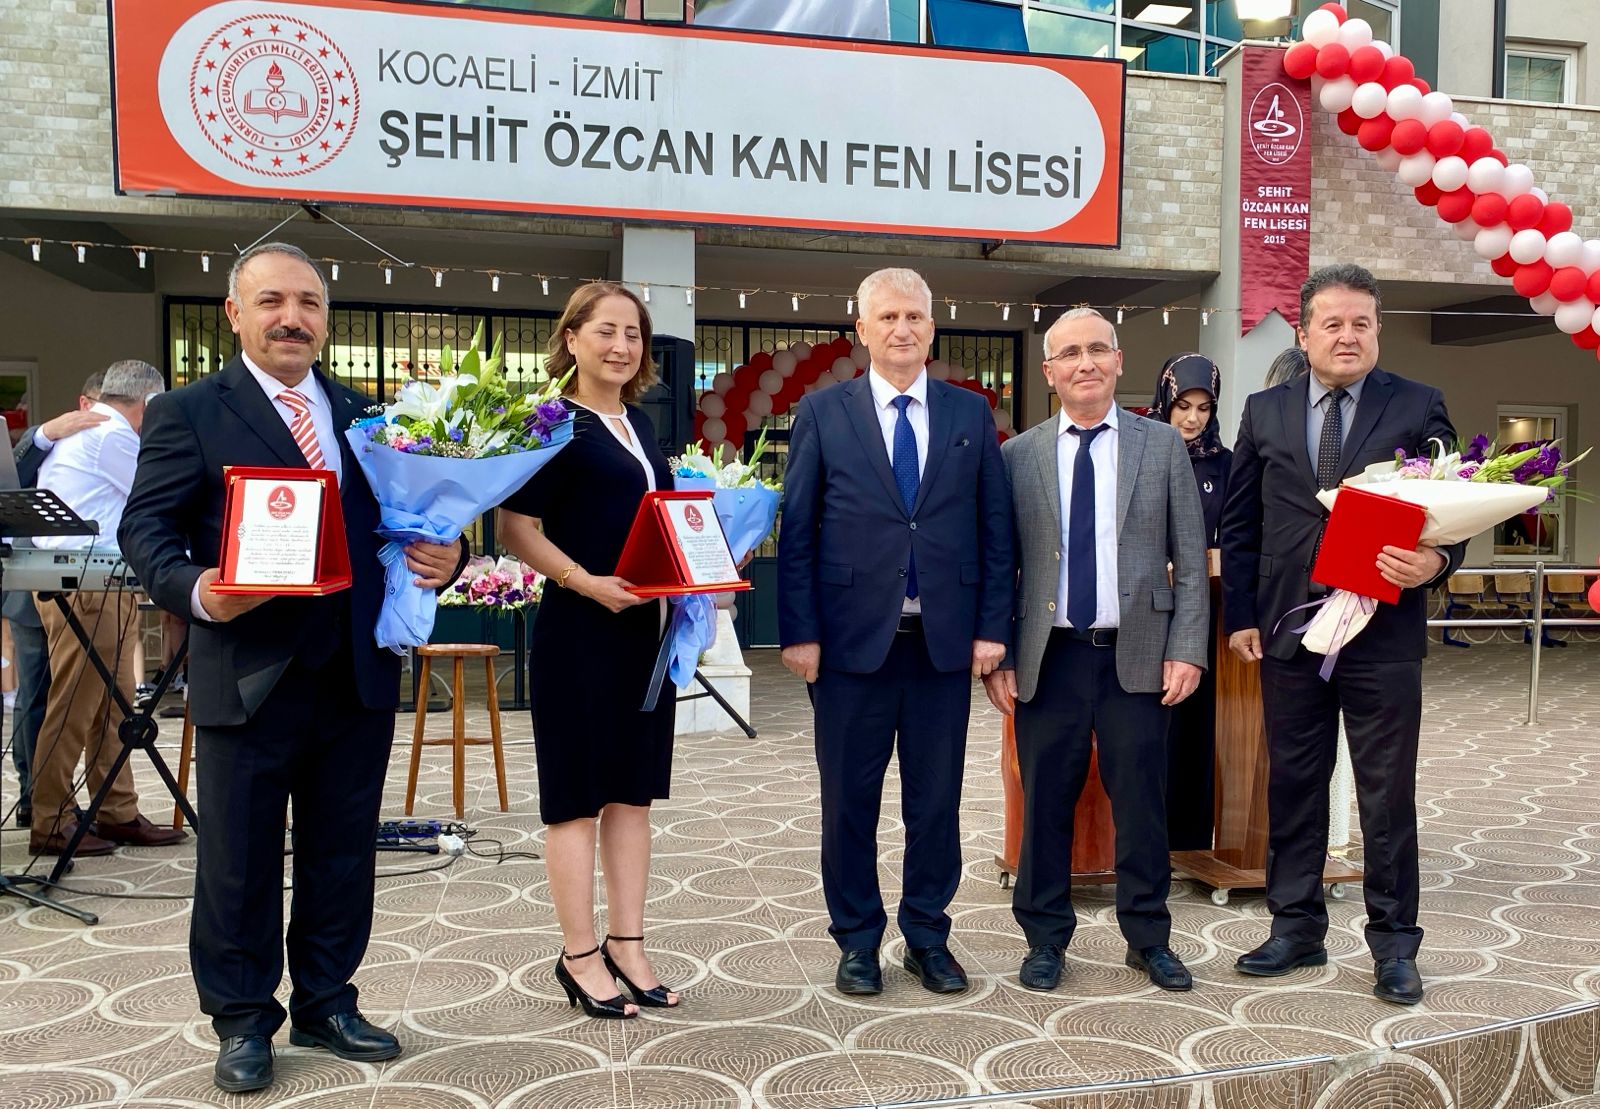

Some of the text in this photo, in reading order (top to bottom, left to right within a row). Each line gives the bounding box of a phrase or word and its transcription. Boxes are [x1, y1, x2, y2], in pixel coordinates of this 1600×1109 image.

[222, 42, 267, 103] CUMHURİYETİ
[303, 58, 329, 95] EĞİTİM
[378, 47, 536, 93] KOCAELİ
[573, 57, 663, 102] İZMİT
[225, 106, 265, 144] TÜRKİYE
[290, 98, 329, 147] BAKANLIĞI
[378, 105, 1082, 199] ŞEHİT ÖZCAN KAN FEN LİSESİ
[1242, 199, 1309, 214] ÖZCAN KAN
[1244, 217, 1267, 229] FEN
[1264, 235, 1286, 244] 2015
